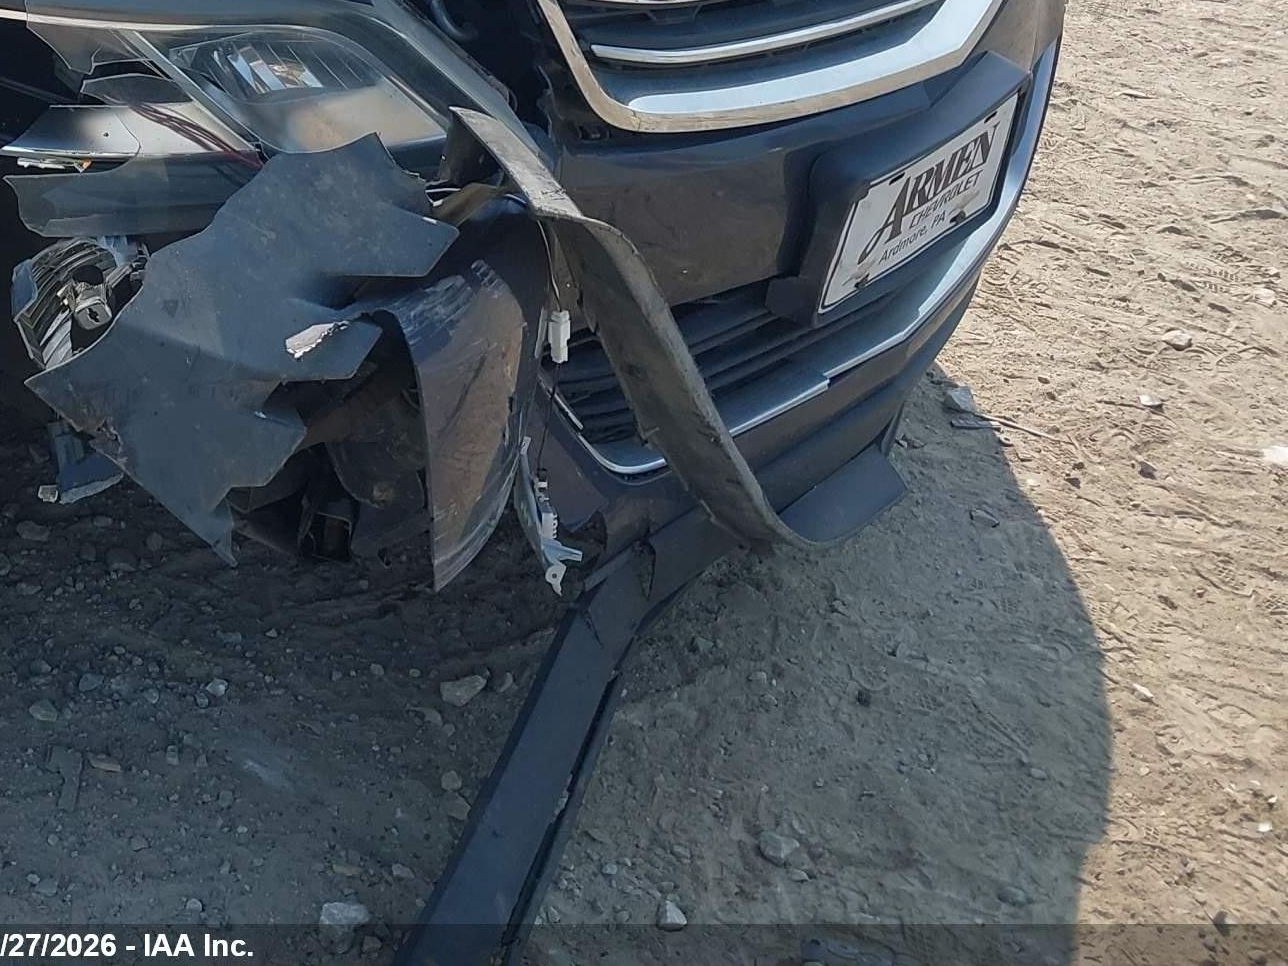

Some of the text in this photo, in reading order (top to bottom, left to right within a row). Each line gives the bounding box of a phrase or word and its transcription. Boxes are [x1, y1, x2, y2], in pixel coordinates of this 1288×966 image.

[856, 121, 1000, 265] ARMEN
[909, 169, 984, 230] CHEVROLET
[930, 209, 947, 230] PA
